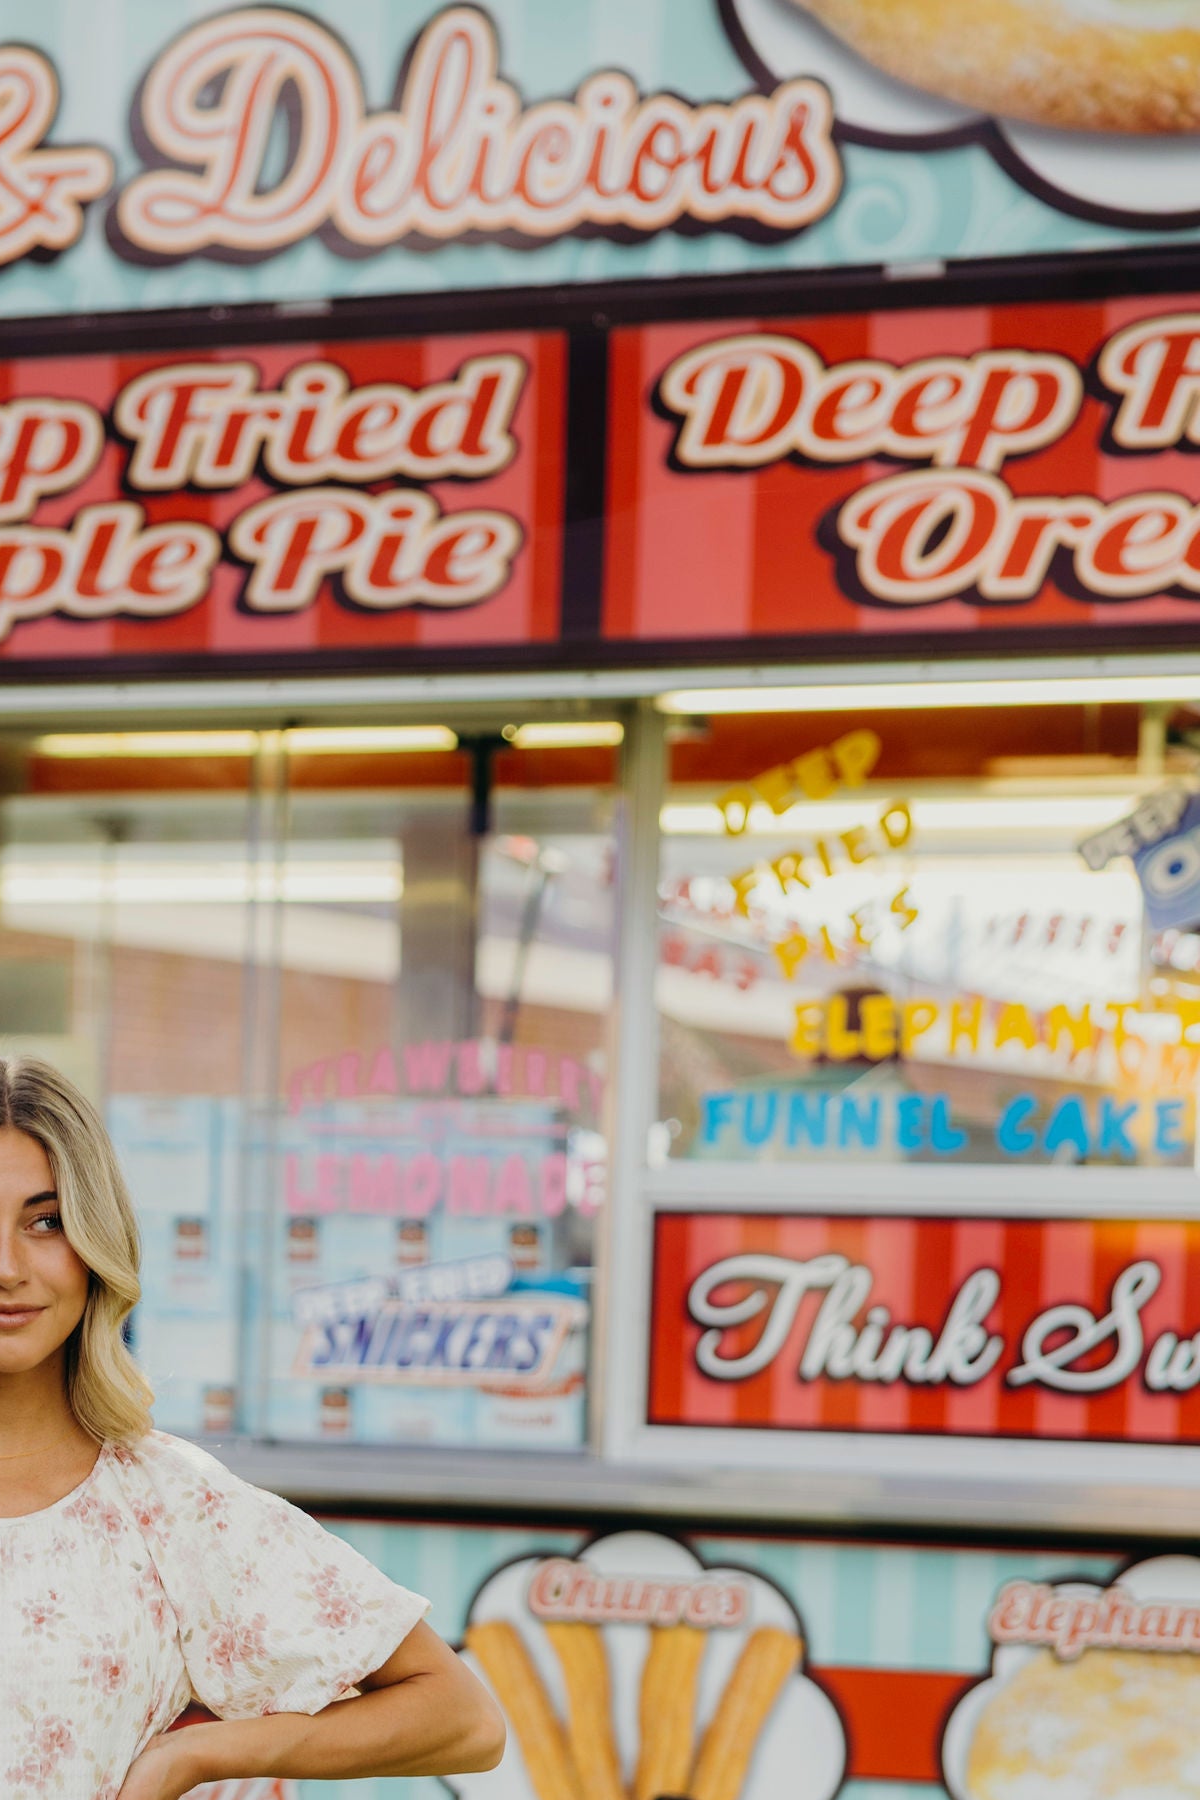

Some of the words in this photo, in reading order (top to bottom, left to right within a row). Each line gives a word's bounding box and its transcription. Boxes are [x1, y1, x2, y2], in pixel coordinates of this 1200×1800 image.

[118, 5, 842, 252] Delicious
[117, 358, 528, 490] Fried
[660, 335, 1084, 470] Deep
[230, 490, 522, 610] Pie
[838, 466, 1200, 600] Ore
[717, 730, 880, 836] DEEP
[728, 802, 913, 918] FRIED
[773, 888, 919, 980] PIES
[790, 993, 1142, 1060] ELEPHANT
[701, 1092, 966, 1151] FUNNEL
[997, 1092, 1184, 1155] CAKE
[312, 1312, 554, 1371] SNICKERS
[687, 1253, 1004, 1386] Think
[528, 1558, 747, 1628] Churros
